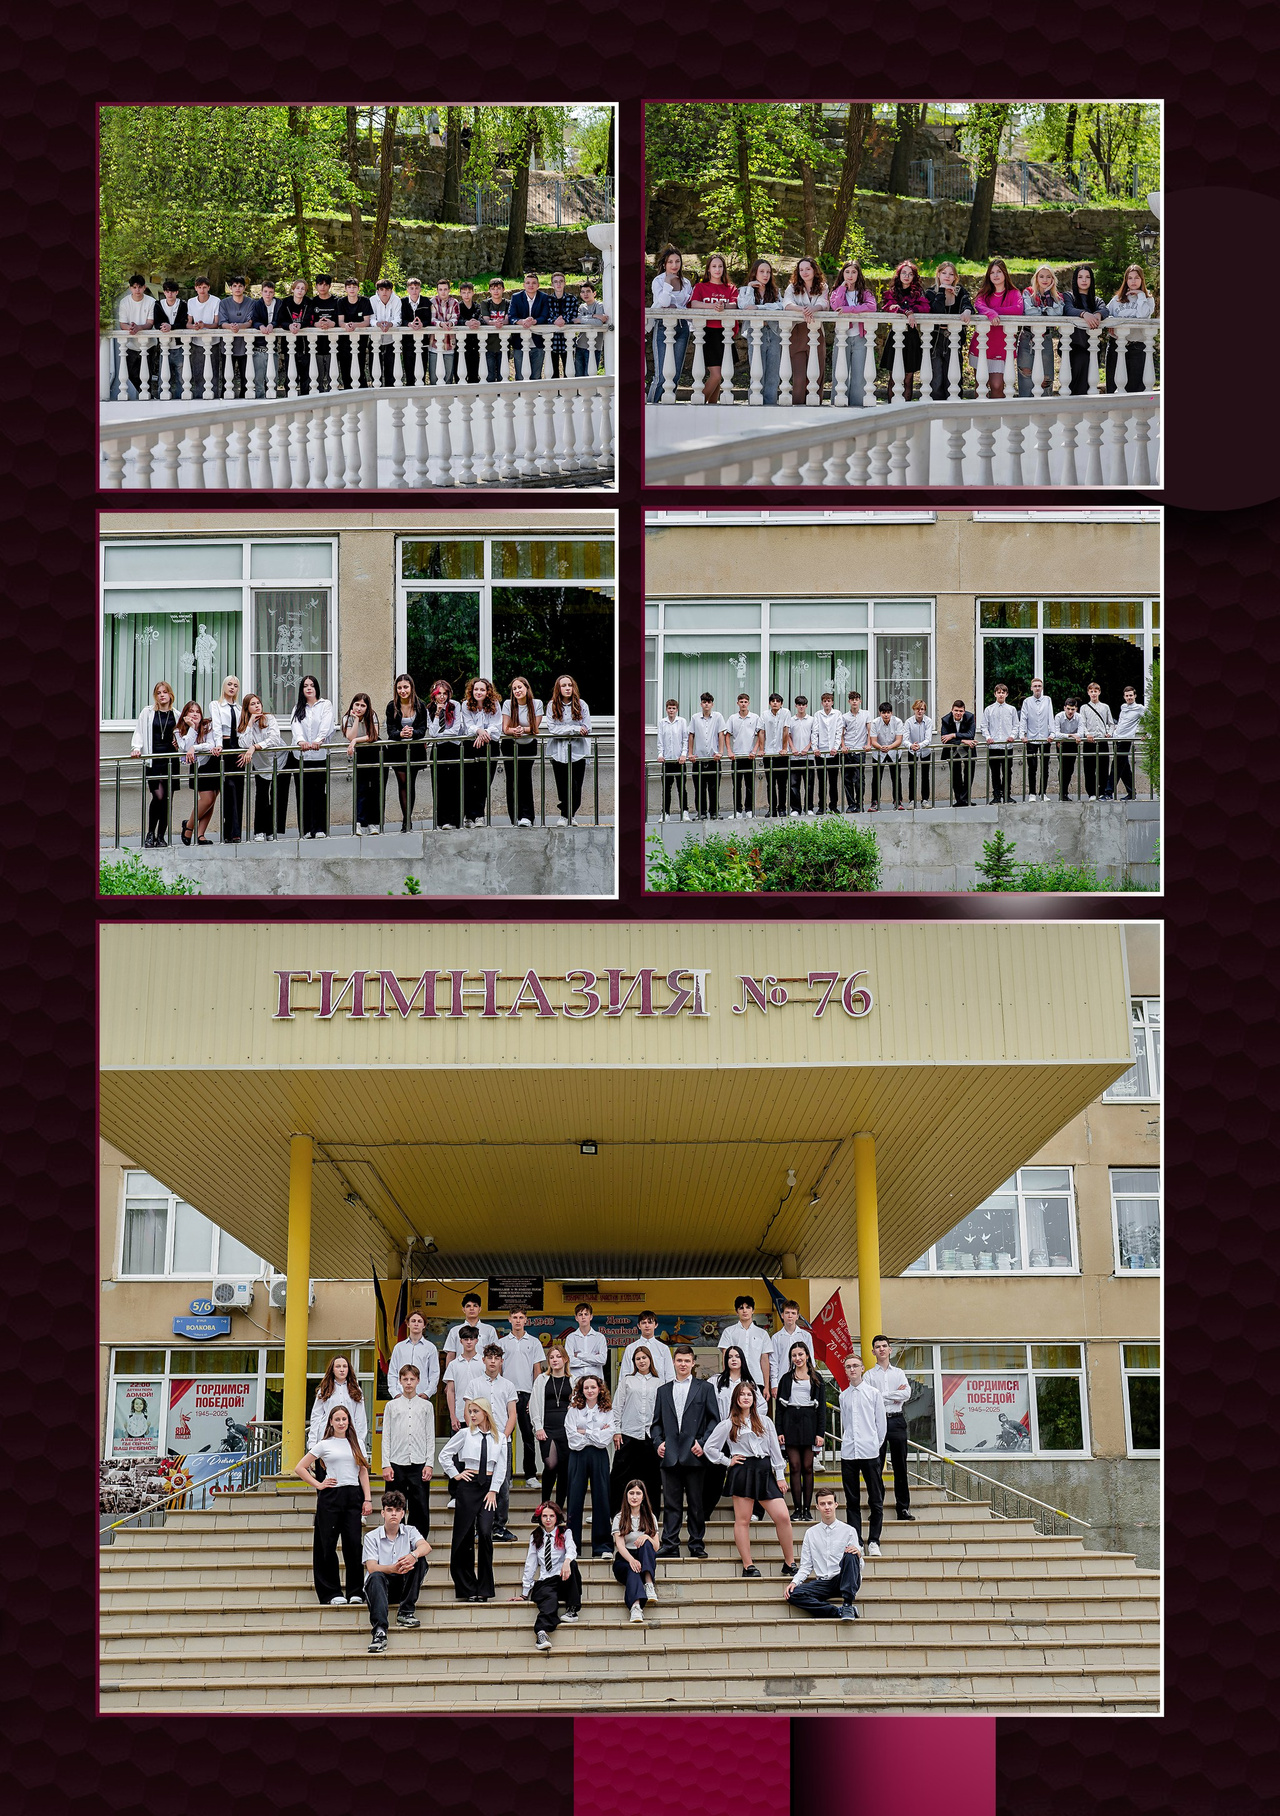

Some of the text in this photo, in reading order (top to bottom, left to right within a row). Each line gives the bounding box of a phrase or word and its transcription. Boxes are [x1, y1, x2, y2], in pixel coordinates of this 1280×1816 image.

[272, 969, 873, 1018] ГИМНАЗИЯ № 76
[192, 1301, 211, 1312] 5/6
[606, 1316, 631, 1325] День
[598, 1326, 638, 1335] Великой
[826, 1339, 838, 1350] 79
[196, 1384, 250, 1396] ГОРДИМСЯ
[967, 1380, 1020, 1392] ГОРДИМСЯ
[195, 1396, 245, 1409] ПОБЕДОЙ!
[967, 1392, 1016, 1405] ПОБЕДОЙ!
